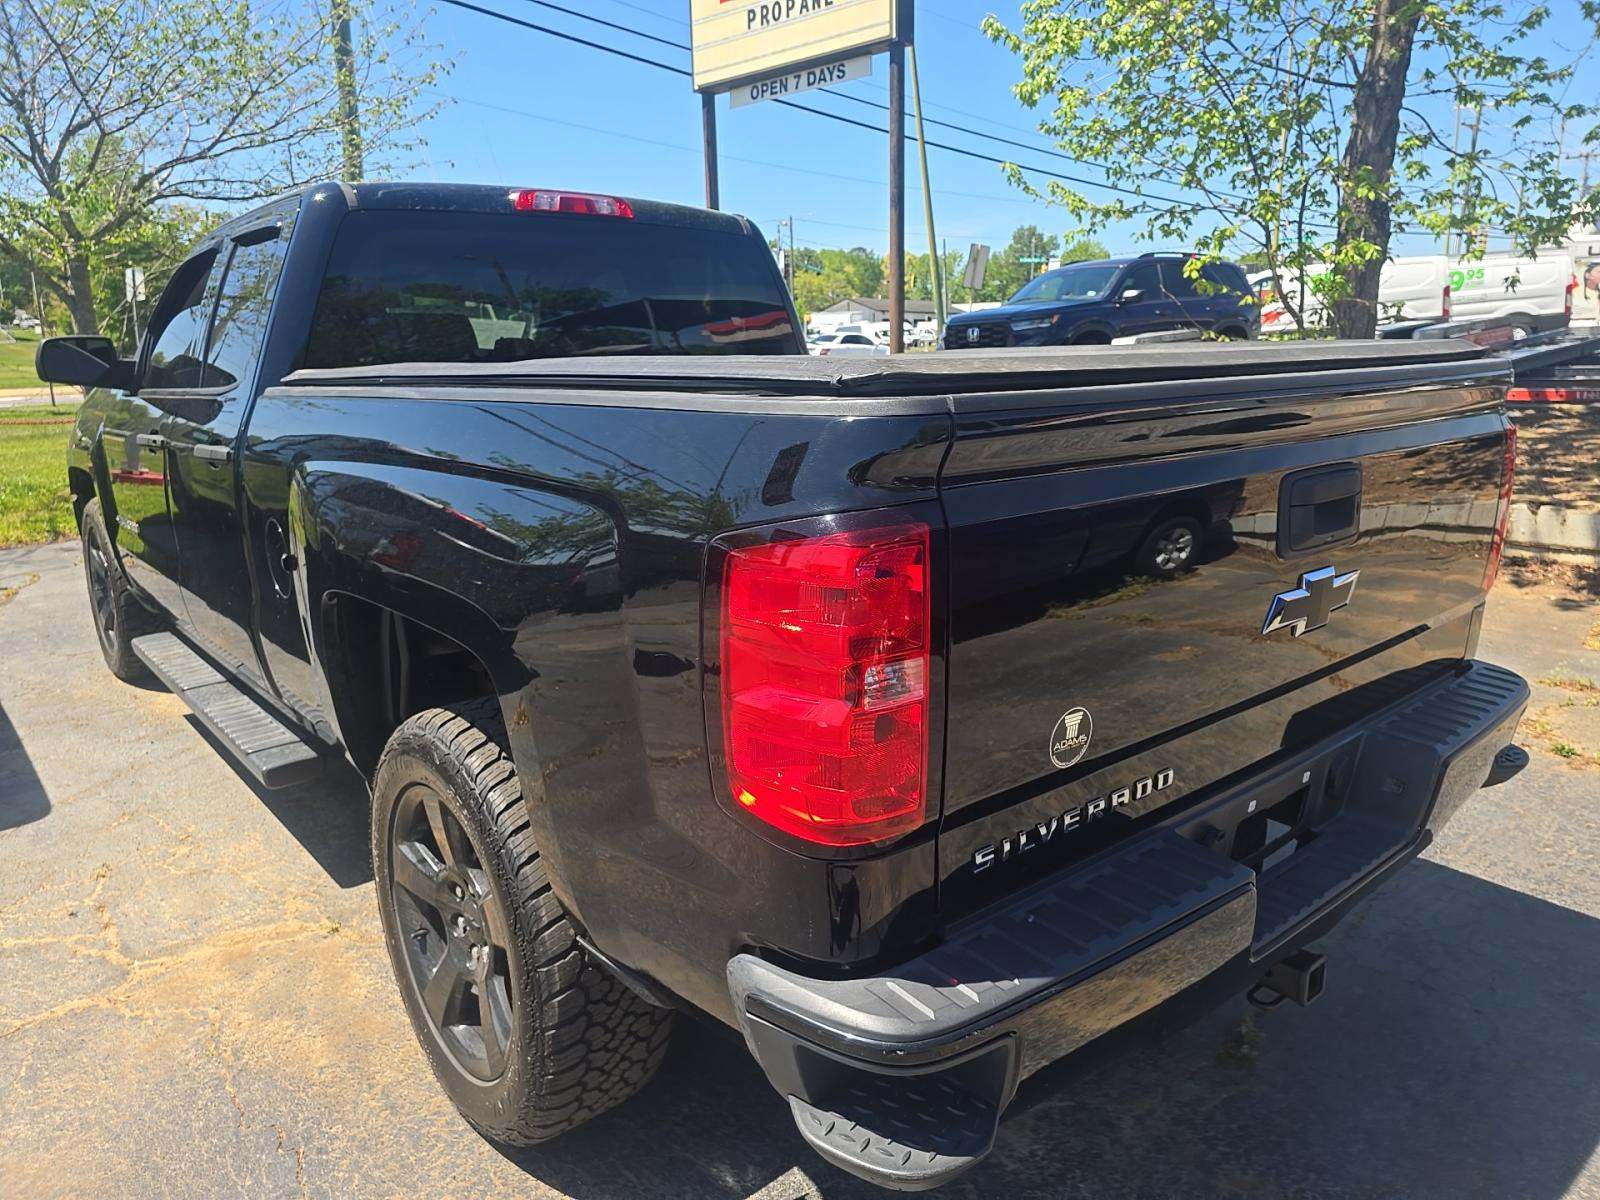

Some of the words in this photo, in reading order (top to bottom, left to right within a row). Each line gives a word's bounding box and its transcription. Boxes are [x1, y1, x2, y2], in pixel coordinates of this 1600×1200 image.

[747, 0, 833, 30] PROPAN
[750, 77, 788, 100] OPEN
[793, 74, 801, 93] 7
[806, 63, 846, 87] DAYS
[1053, 734, 1087, 752] ADAMS
[973, 767, 1174, 874] SILVERADO
